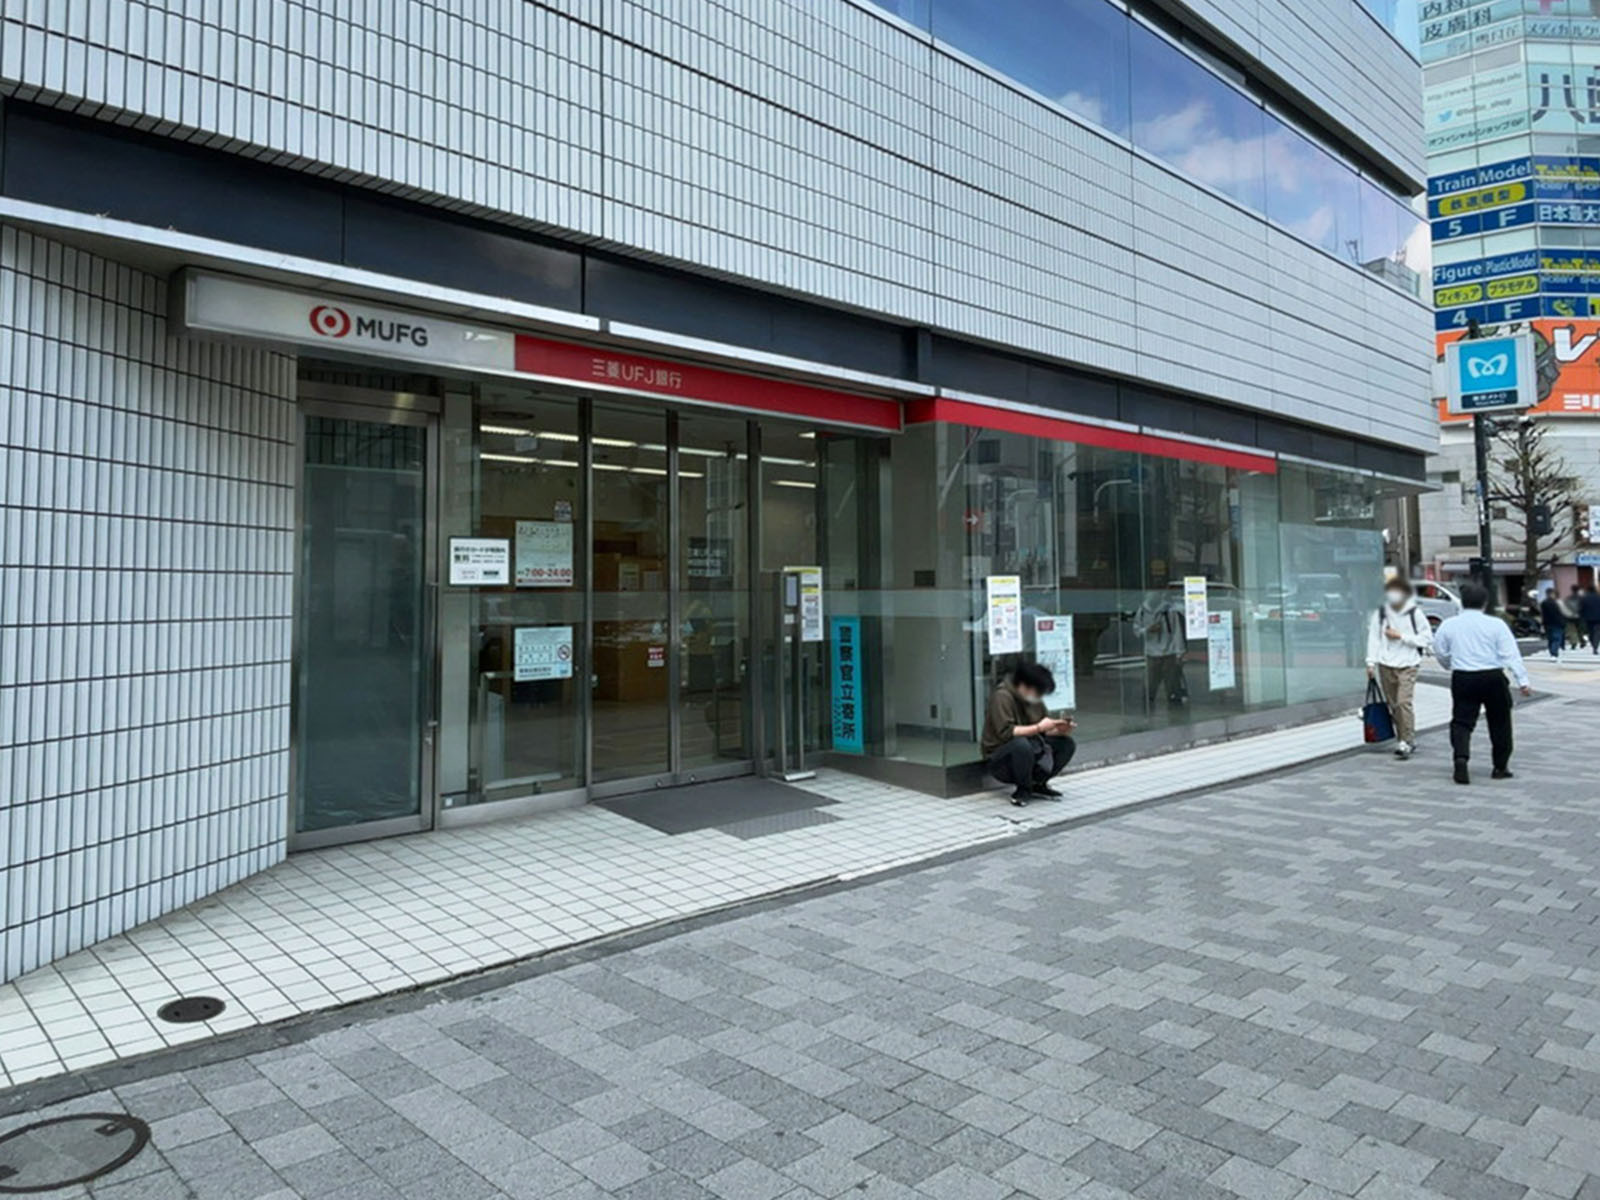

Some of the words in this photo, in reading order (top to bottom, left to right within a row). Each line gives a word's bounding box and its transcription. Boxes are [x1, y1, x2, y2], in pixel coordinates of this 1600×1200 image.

[1435, 175, 1476, 193] Train
[1479, 160, 1531, 184] Model
[1448, 219, 1463, 236] 5
[1499, 209, 1517, 226] F
[1539, 204, 1600, 222] 日本最大
[1433, 262, 1482, 282] Figure
[1452, 309, 1468, 326] 4
[1504, 302, 1522, 319] F
[356, 316, 429, 347] MUFG
[591, 357, 683, 389] 三菱UFJ銀行
